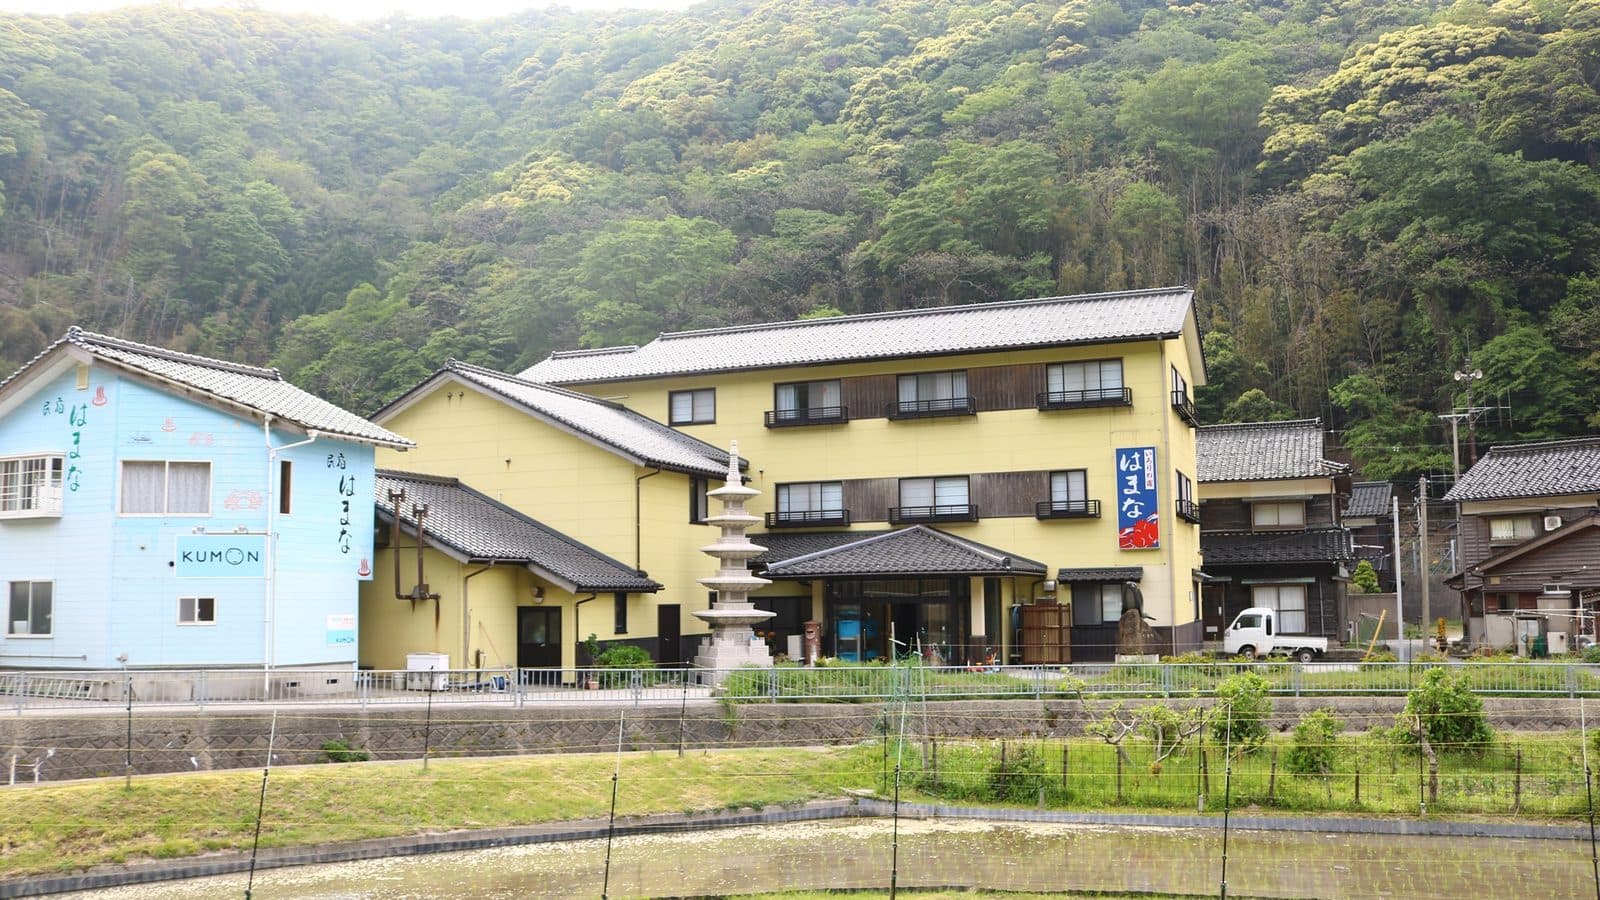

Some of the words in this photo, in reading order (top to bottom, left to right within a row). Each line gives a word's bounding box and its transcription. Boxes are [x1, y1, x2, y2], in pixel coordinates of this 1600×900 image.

[67, 403, 87, 492] はまな
[339, 475, 355, 554] はまな
[1120, 451, 1144, 518] はまな
[182, 547, 259, 566] KUMON
